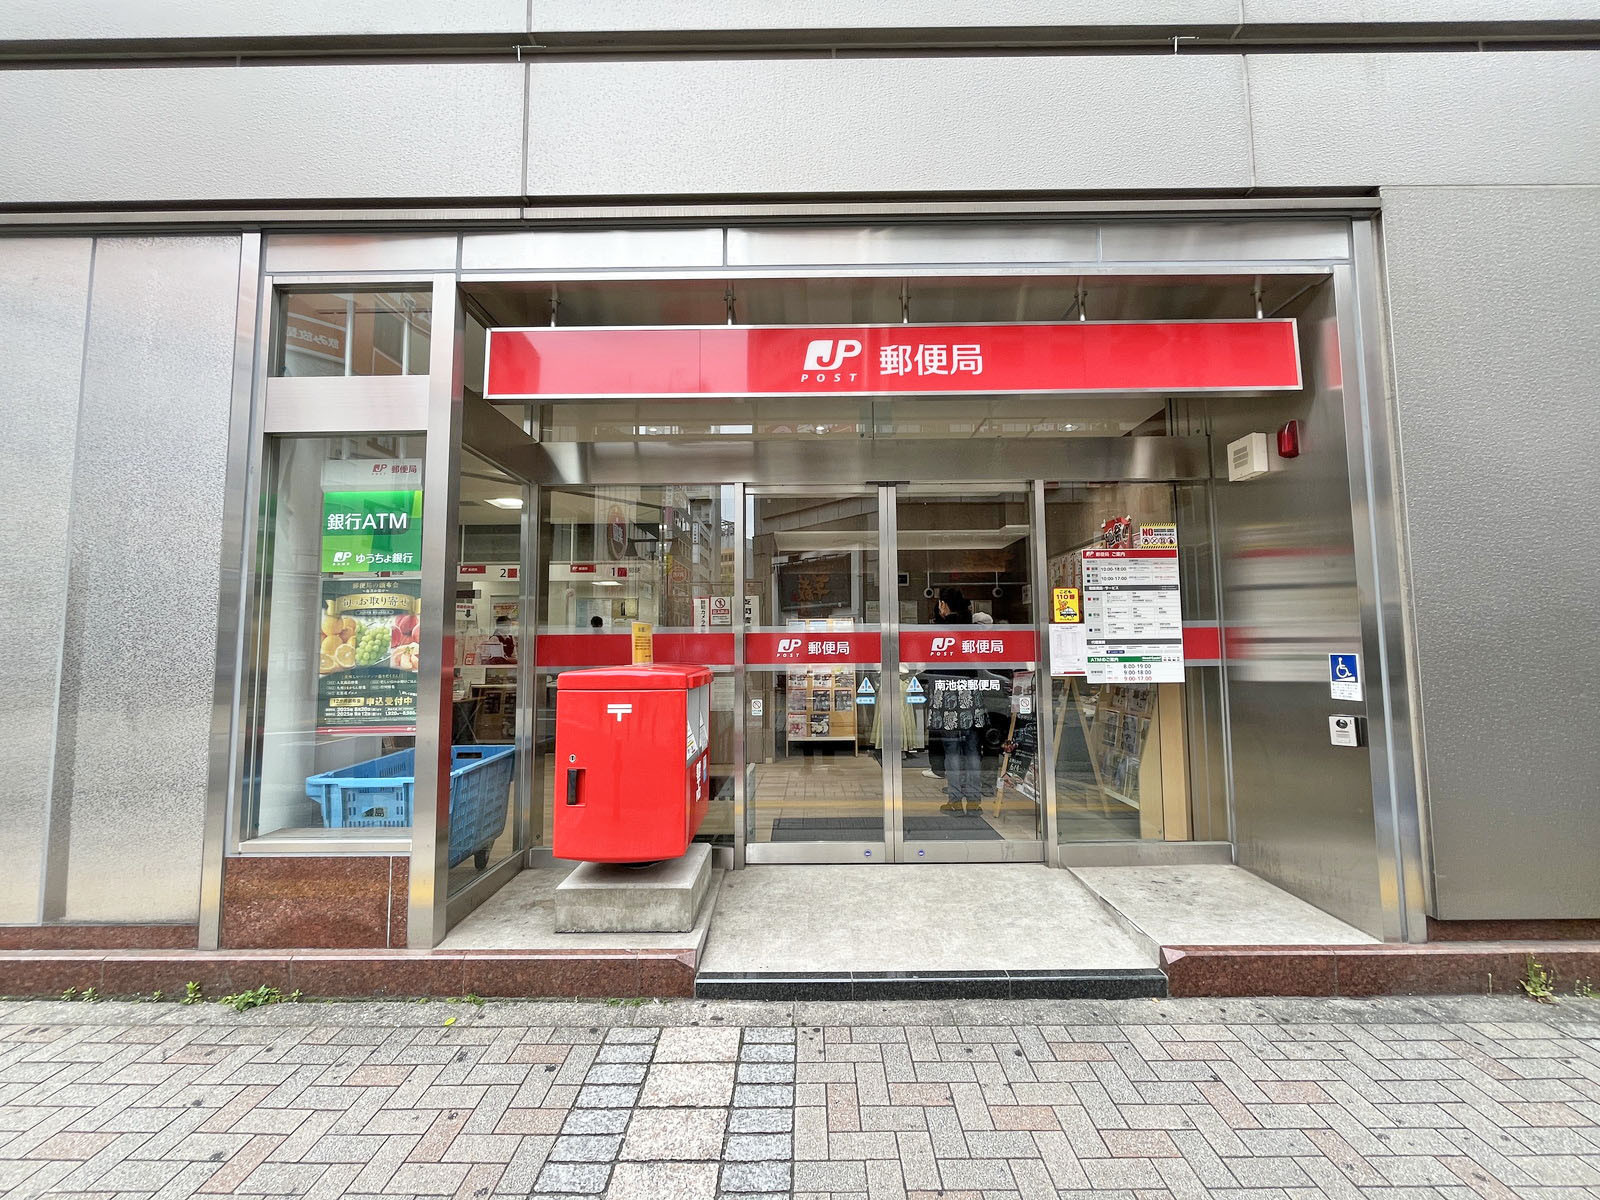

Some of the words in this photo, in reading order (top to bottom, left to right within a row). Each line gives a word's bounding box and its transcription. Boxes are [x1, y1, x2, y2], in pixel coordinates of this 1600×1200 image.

[880, 344, 984, 376] 郵便局
[800, 373, 857, 382] POST
[391, 465, 417, 473] 郵便局
[327, 512, 408, 530] 銀行ATM
[1142, 528, 1153, 536] NO
[355, 552, 413, 563] ゆうちょ銀行
[499, 568, 507, 578] 2
[808, 641, 850, 655] 郵便局
[961, 640, 1004, 654] 郵便局
[934, 679, 1001, 691] 南池袋郵便局
[366, 696, 413, 706] 申込受付中
